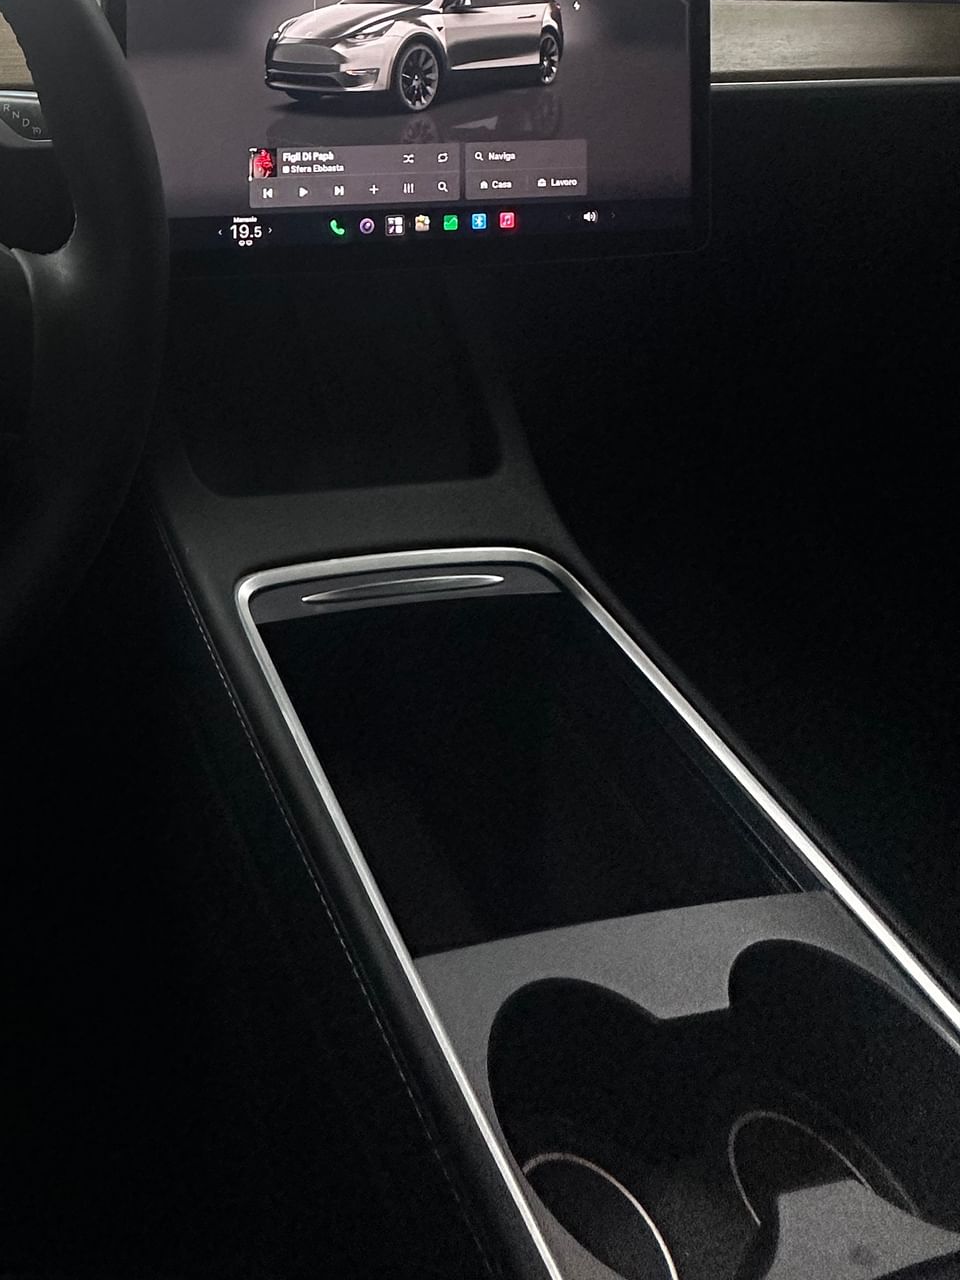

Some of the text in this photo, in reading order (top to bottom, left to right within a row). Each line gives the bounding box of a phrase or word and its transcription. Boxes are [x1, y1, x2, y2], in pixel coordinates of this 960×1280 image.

[3, 103, 30, 127] R N D
[282, 152, 301, 163] Figli
[302, 151, 312, 161] Di
[488, 152, 516, 162] Naviga
[290, 164, 345, 174] Sfera Ebbasta
[491, 180, 512, 189] Casa
[551, 178, 578, 187] Lavoro
[230, 223, 262, 239] 19.5
